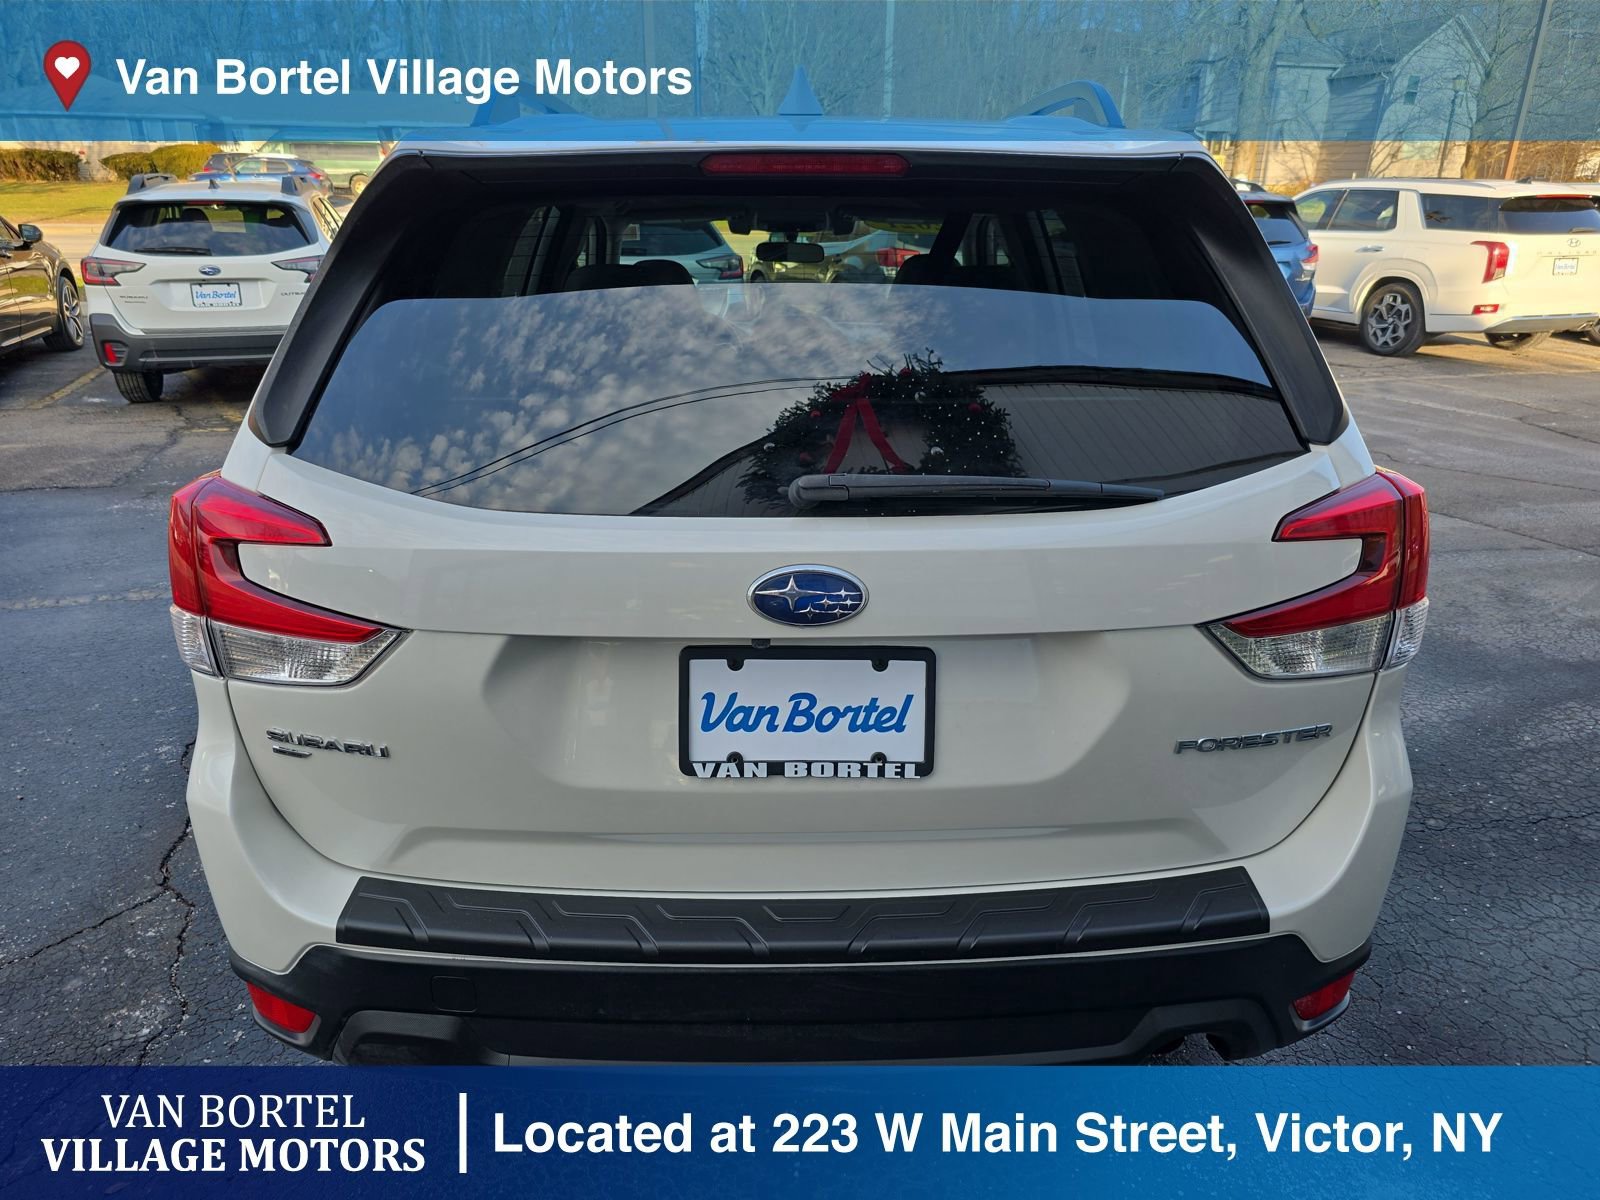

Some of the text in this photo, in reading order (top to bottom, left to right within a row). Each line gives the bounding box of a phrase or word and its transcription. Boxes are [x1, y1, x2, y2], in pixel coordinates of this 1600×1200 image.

[701, 691, 914, 734] Van Bortel
[266, 727, 390, 758] SUBARU
[1173, 722, 1333, 755] FORESTER
[692, 761, 921, 780] VAN BORTEL
